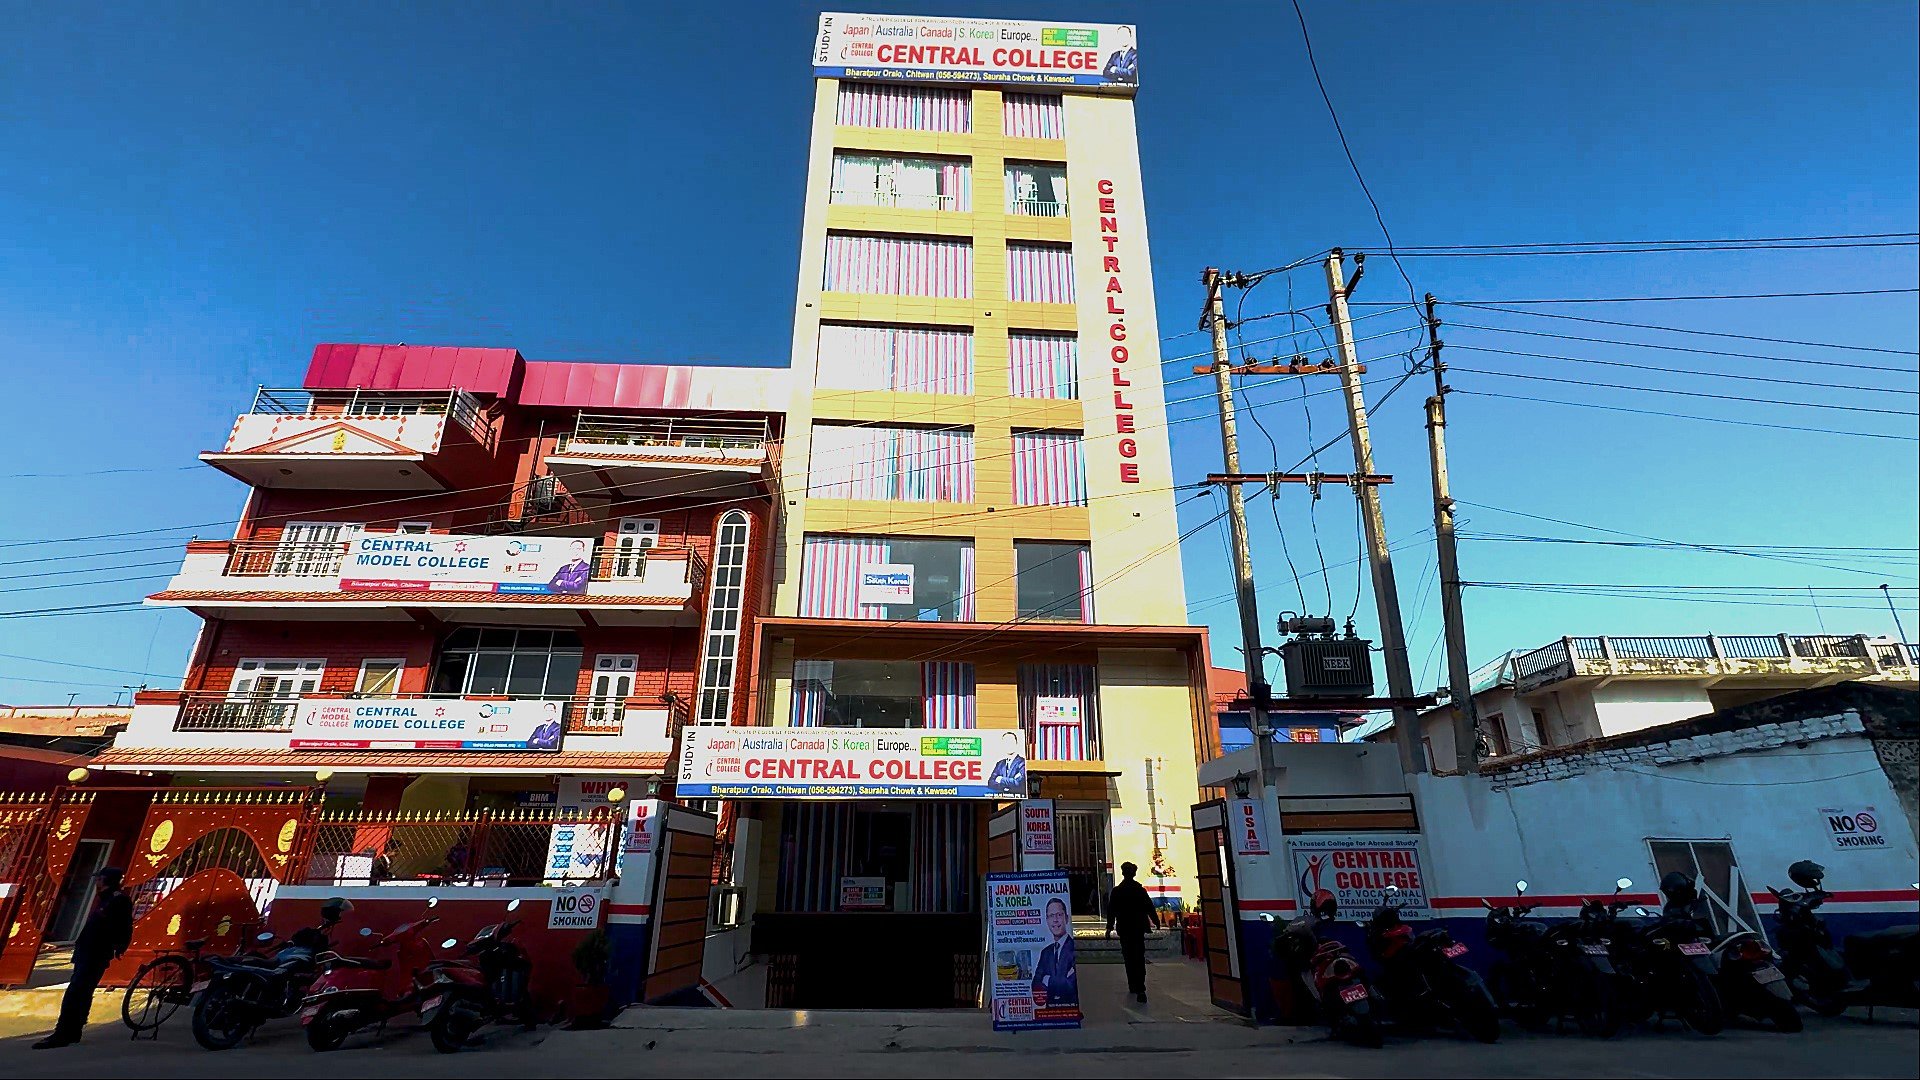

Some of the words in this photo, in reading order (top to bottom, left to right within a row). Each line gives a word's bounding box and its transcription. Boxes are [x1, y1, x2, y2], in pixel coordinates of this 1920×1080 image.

[825, 17, 833, 27] IN
[842, 24, 870, 37] Japan
[875, 24, 914, 37] Australia
[920, 26, 953, 38] Canada
[958, 27, 967, 38] S.
[969, 28, 995, 40] Korea
[820, 30, 832, 63] STUDY
[877, 44, 985, 66] CENTRAL
[992, 48, 1098, 70] COLLEGE
[845, 68, 881, 77] Bharatpur
[1012, 73, 1036, 82] Chowk
[1097, 178, 1125, 315] CENTRAL
[1109, 322, 1140, 484] COLLEGE
[361, 539, 434, 552] CENTRAL
[356, 554, 412, 567] MODEL
[417, 556, 490, 569] COLLEGE
[1323, 658, 1350, 669] NEEK
[356, 706, 418, 717] CENTRAL
[353, 719, 400, 729] MODEL
[403, 719, 466, 729] COLLEGE
[687, 731, 696, 742] IN
[707, 738, 735, 752] Japan
[742, 738, 783, 749] Australia
[790, 739, 825, 750] Canada
[832, 739, 841, 750] S.
[843, 739, 870, 750] Korea
[682, 744, 695, 780] STUDY
[744, 758, 861, 779] CENTRAL
[868, 759, 982, 781] COLLEGE
[711, 785, 749, 796] Bharatpur
[776, 785, 807, 795] Chitwan
[890, 786, 915, 795] Chowk
[529, 793, 550, 802] BHM
[1024, 808, 1050, 819] SOUTH
[1026, 821, 1051, 832] KOREA
[1243, 805, 1258, 840] USA
[1828, 815, 1856, 832] NO
[1327, 840, 1355, 848] College
[1836, 835, 1885, 847] SMOKING
[1332, 851, 1416, 869] CENTRAL
[1335, 871, 1420, 890] COLLEGE
[995, 884, 1020, 896] JAPAN
[1024, 882, 1069, 895] AUSTRALIA
[1338, 890, 1352, 898] OF
[555, 895, 577, 912] NO
[995, 897, 1004, 908] S.
[1005, 896, 1033, 908] KOREA
[552, 915, 593, 926] SMOKING
[1008, 998, 1032, 1006] CENTRAL
